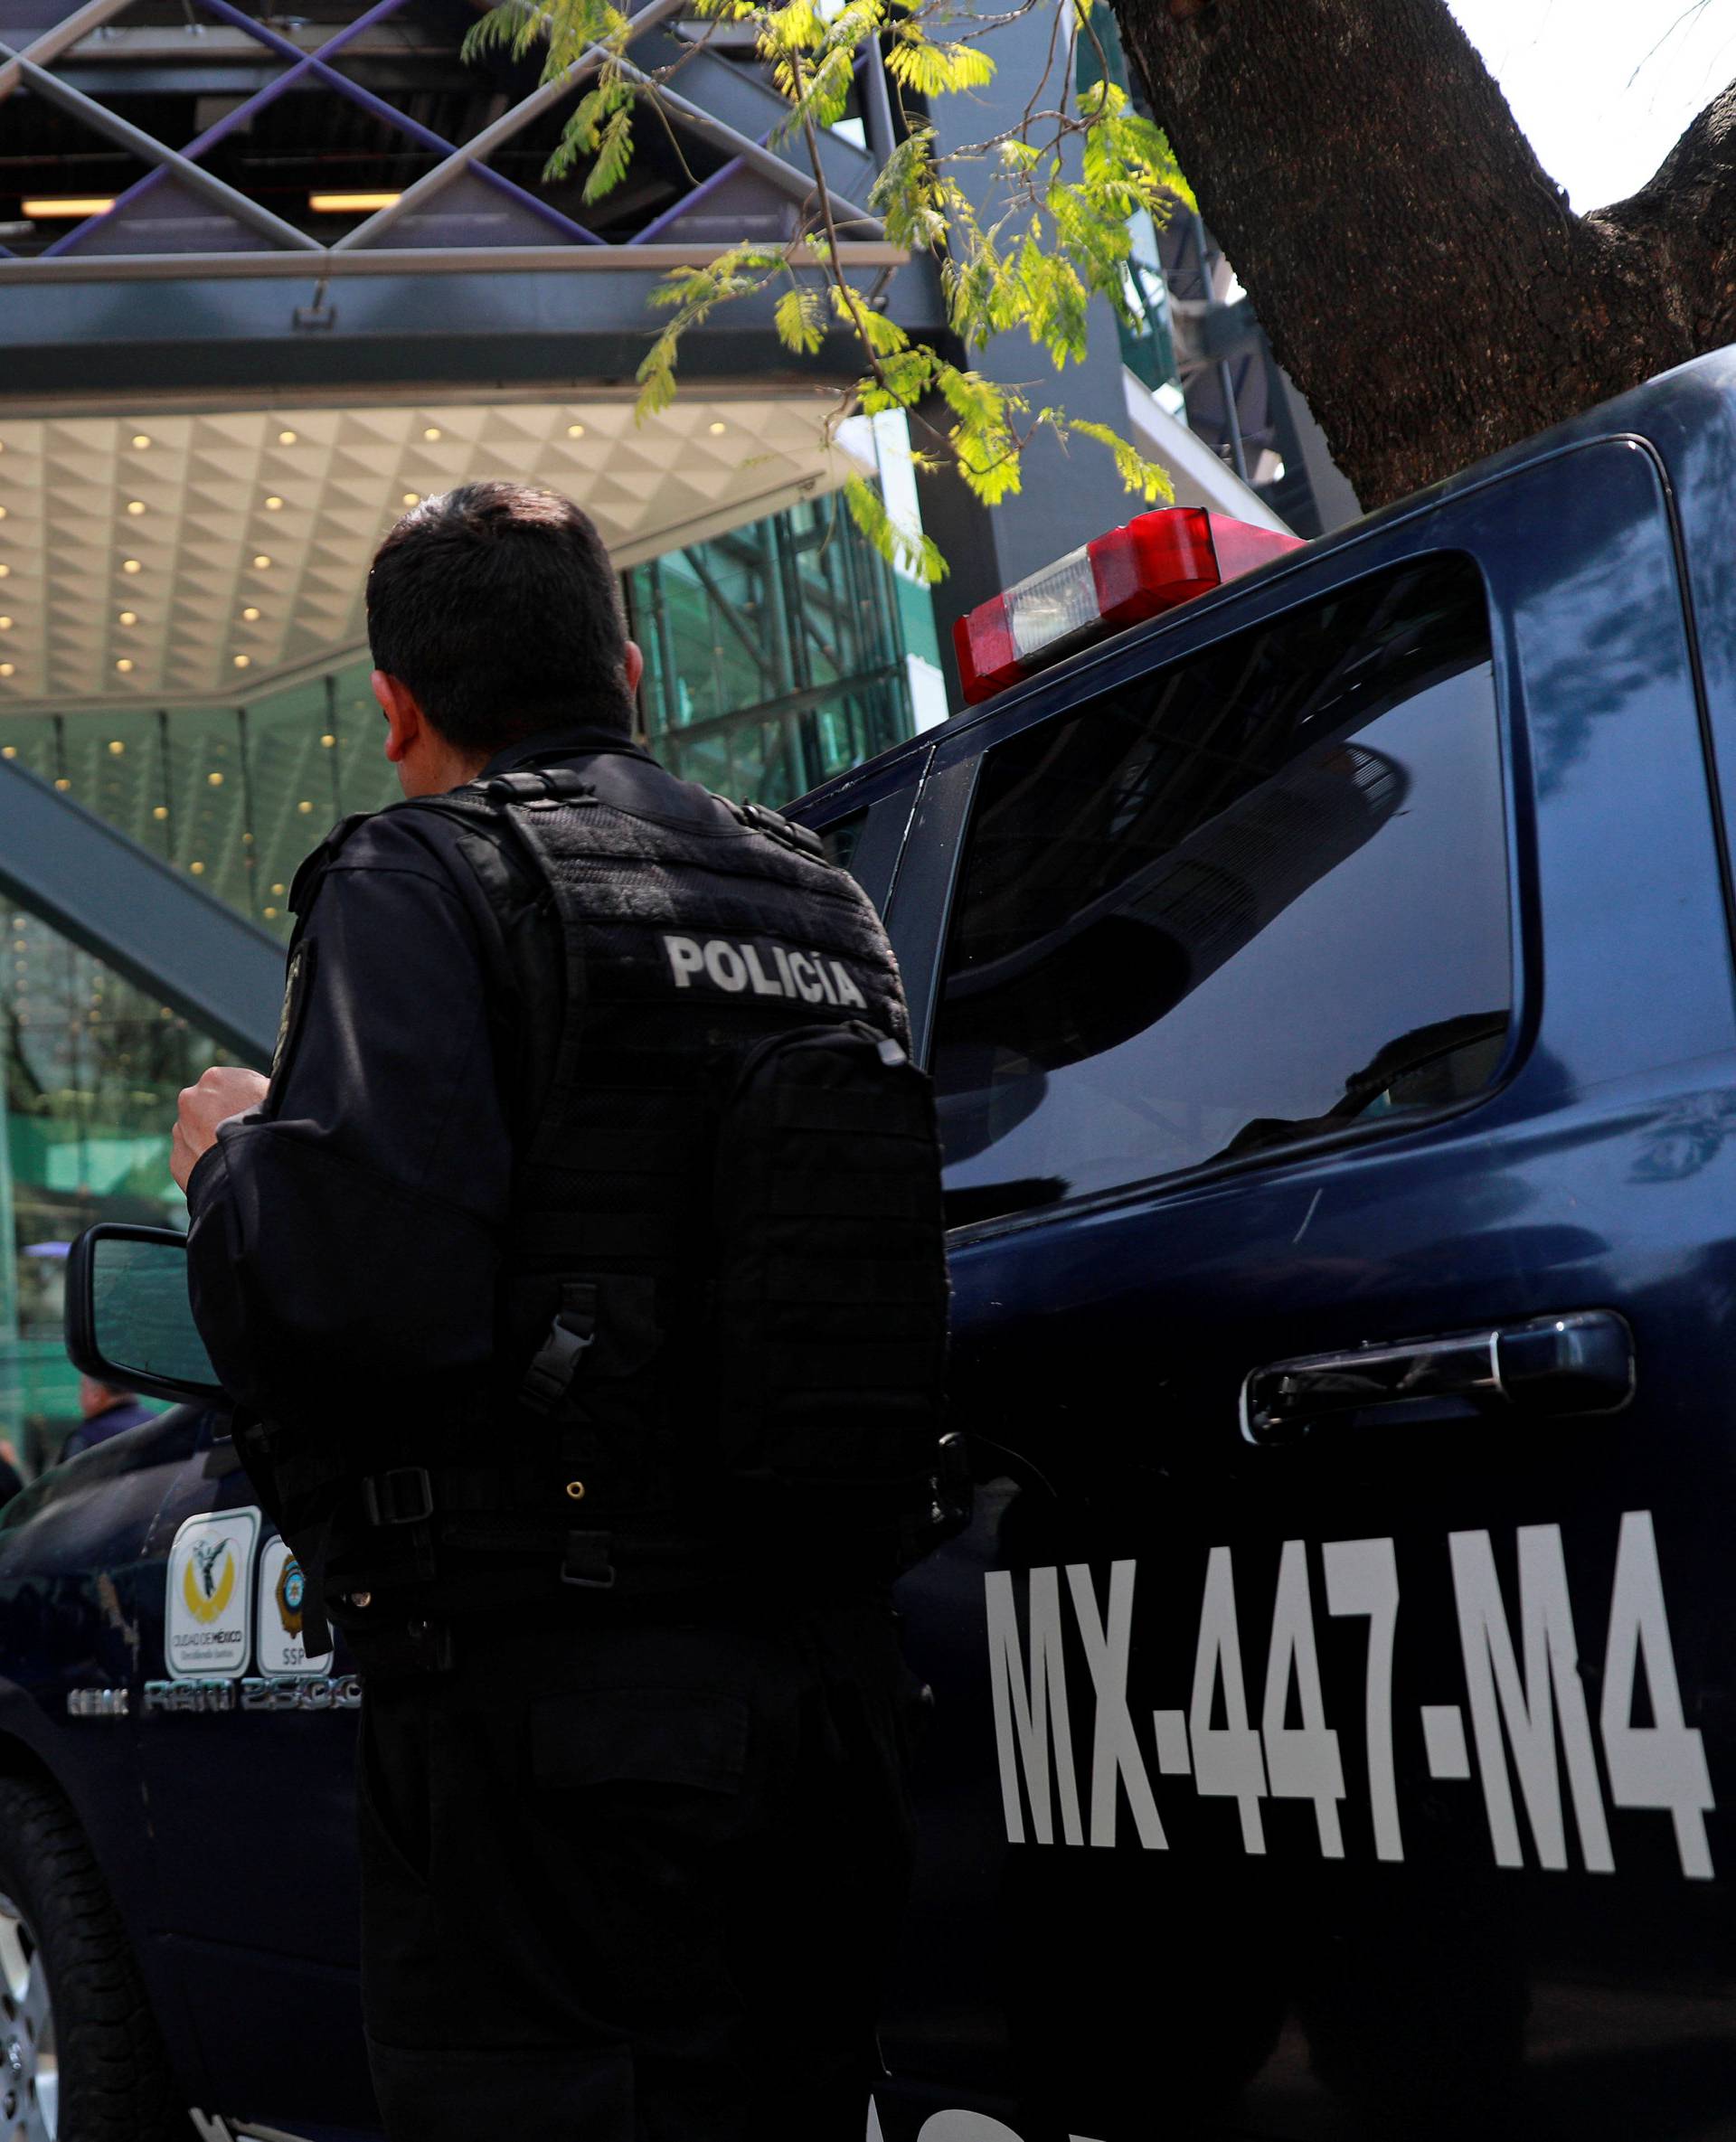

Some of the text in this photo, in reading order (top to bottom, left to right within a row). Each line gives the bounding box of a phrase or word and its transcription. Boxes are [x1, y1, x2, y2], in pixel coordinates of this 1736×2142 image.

[663, 935, 868, 1009] POLICÍA
[282, 1648, 305, 1665] SSP
[985, 1510, 1714, 1880] MX-447-M4
